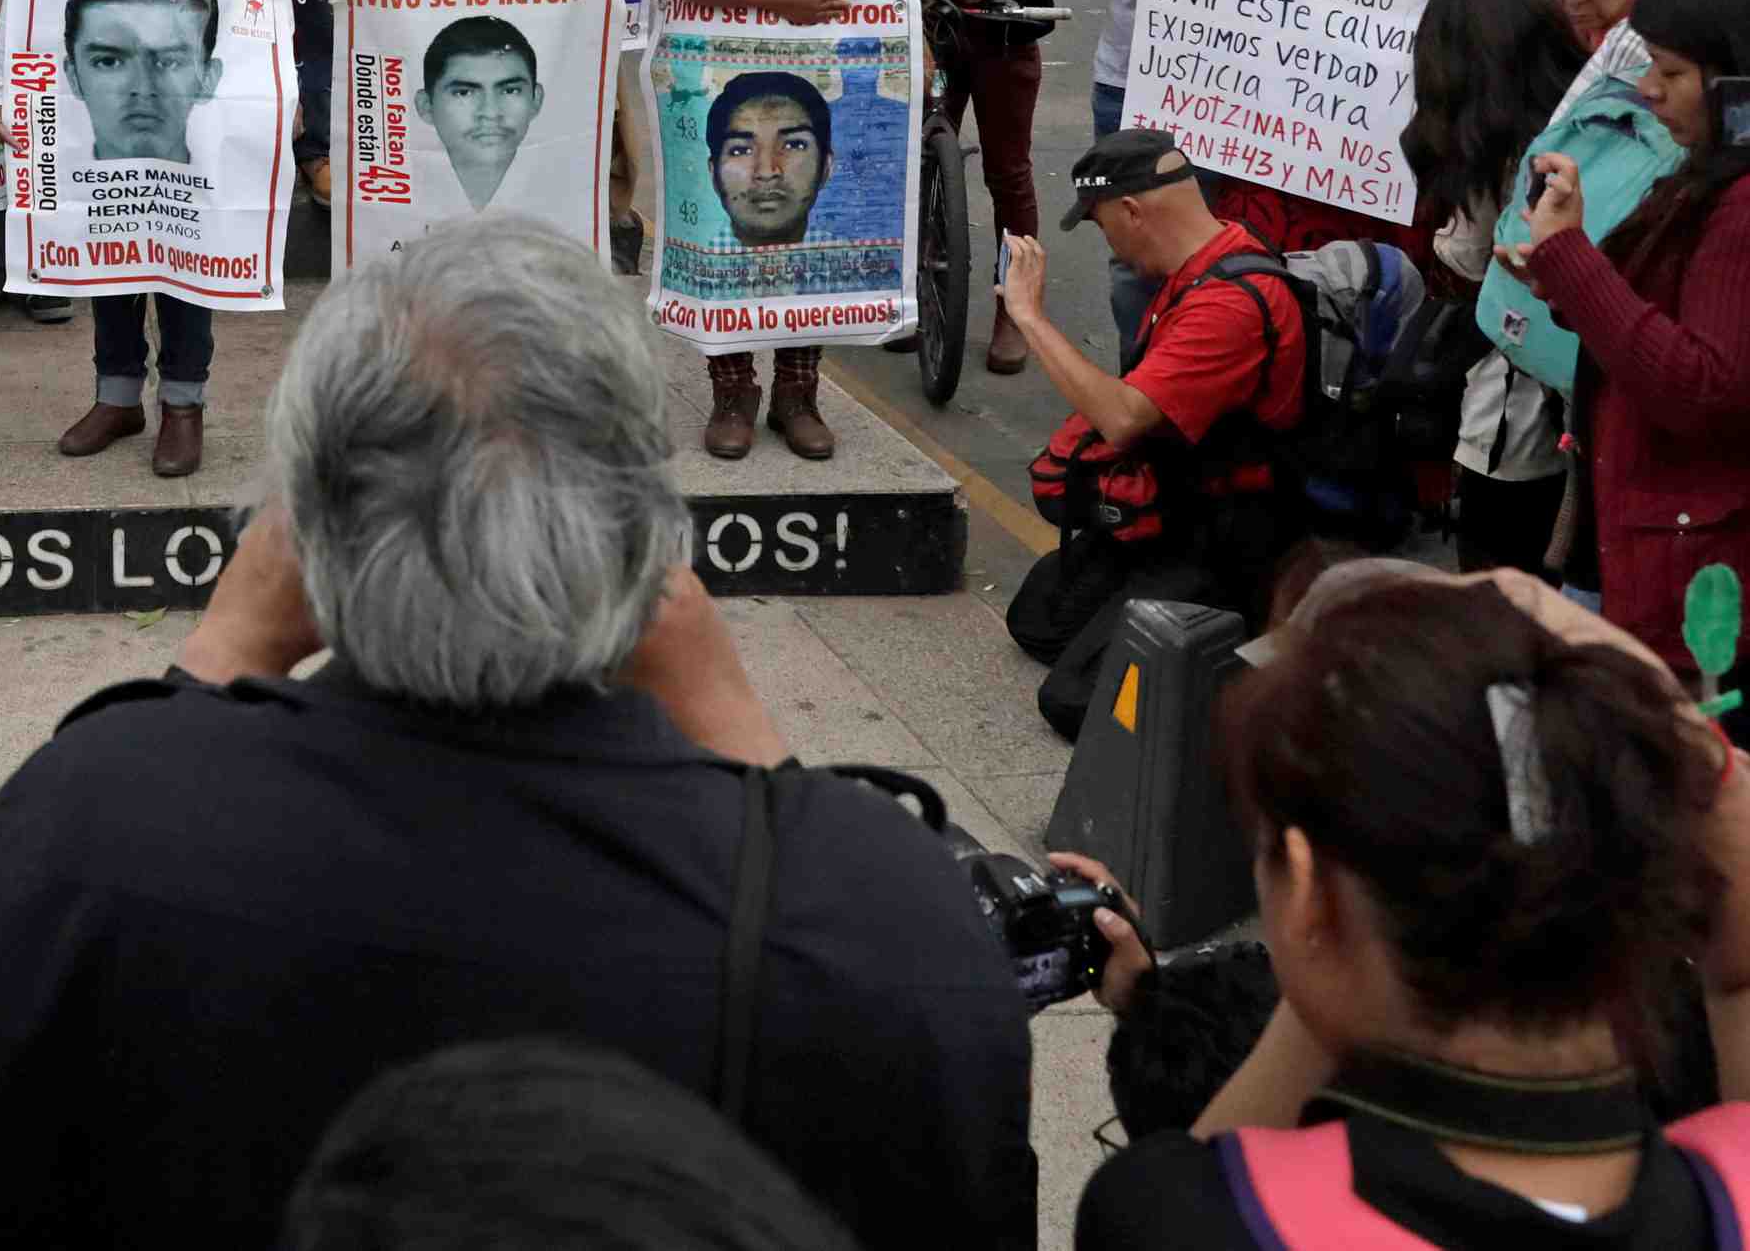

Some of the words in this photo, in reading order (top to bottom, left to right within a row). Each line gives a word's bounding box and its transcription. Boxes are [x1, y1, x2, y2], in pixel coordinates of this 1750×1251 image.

[721, 3, 747, 23] se
[11, 52, 56, 94] 43!
[355, 54, 376, 108] Dónde
[384, 56, 403, 97] Nos
[12, 93, 32, 159] faltan
[40, 95, 57, 150] están
[356, 109, 376, 163] están
[387, 103, 406, 166] faltan
[1160, 84, 1323, 152] AYOTZINAPA
[1339, 135, 1393, 173] NOS
[15, 166, 31, 208] Nos
[39, 152, 58, 212] Dónde
[72, 168, 140, 184] CÉSAR
[145, 168, 215, 191] MANUEL
[92, 184, 193, 204] GONZÁLEZ
[358, 164, 412, 205] 43!
[1217, 137, 1274, 177] #43
[1306, 165, 1403, 213] MAS!!
[87, 201, 200, 223] HERNÁNDEZ
[88, 222, 140, 235] EDAD
[147, 220, 164, 234] 19
[165, 222, 202, 240] AÑOS
[40, 240, 80, 269] ¡Con
[85, 240, 142, 268] VIDA
[147, 238, 165, 264] lo
[167, 243, 258, 282] queremos!
[662, 300, 696, 328] ¡Con
[701, 307, 753, 333] VIDA
[758, 305, 779, 330] lo
[784, 298, 894, 333] queremos!
[111, 524, 225, 589] LO
